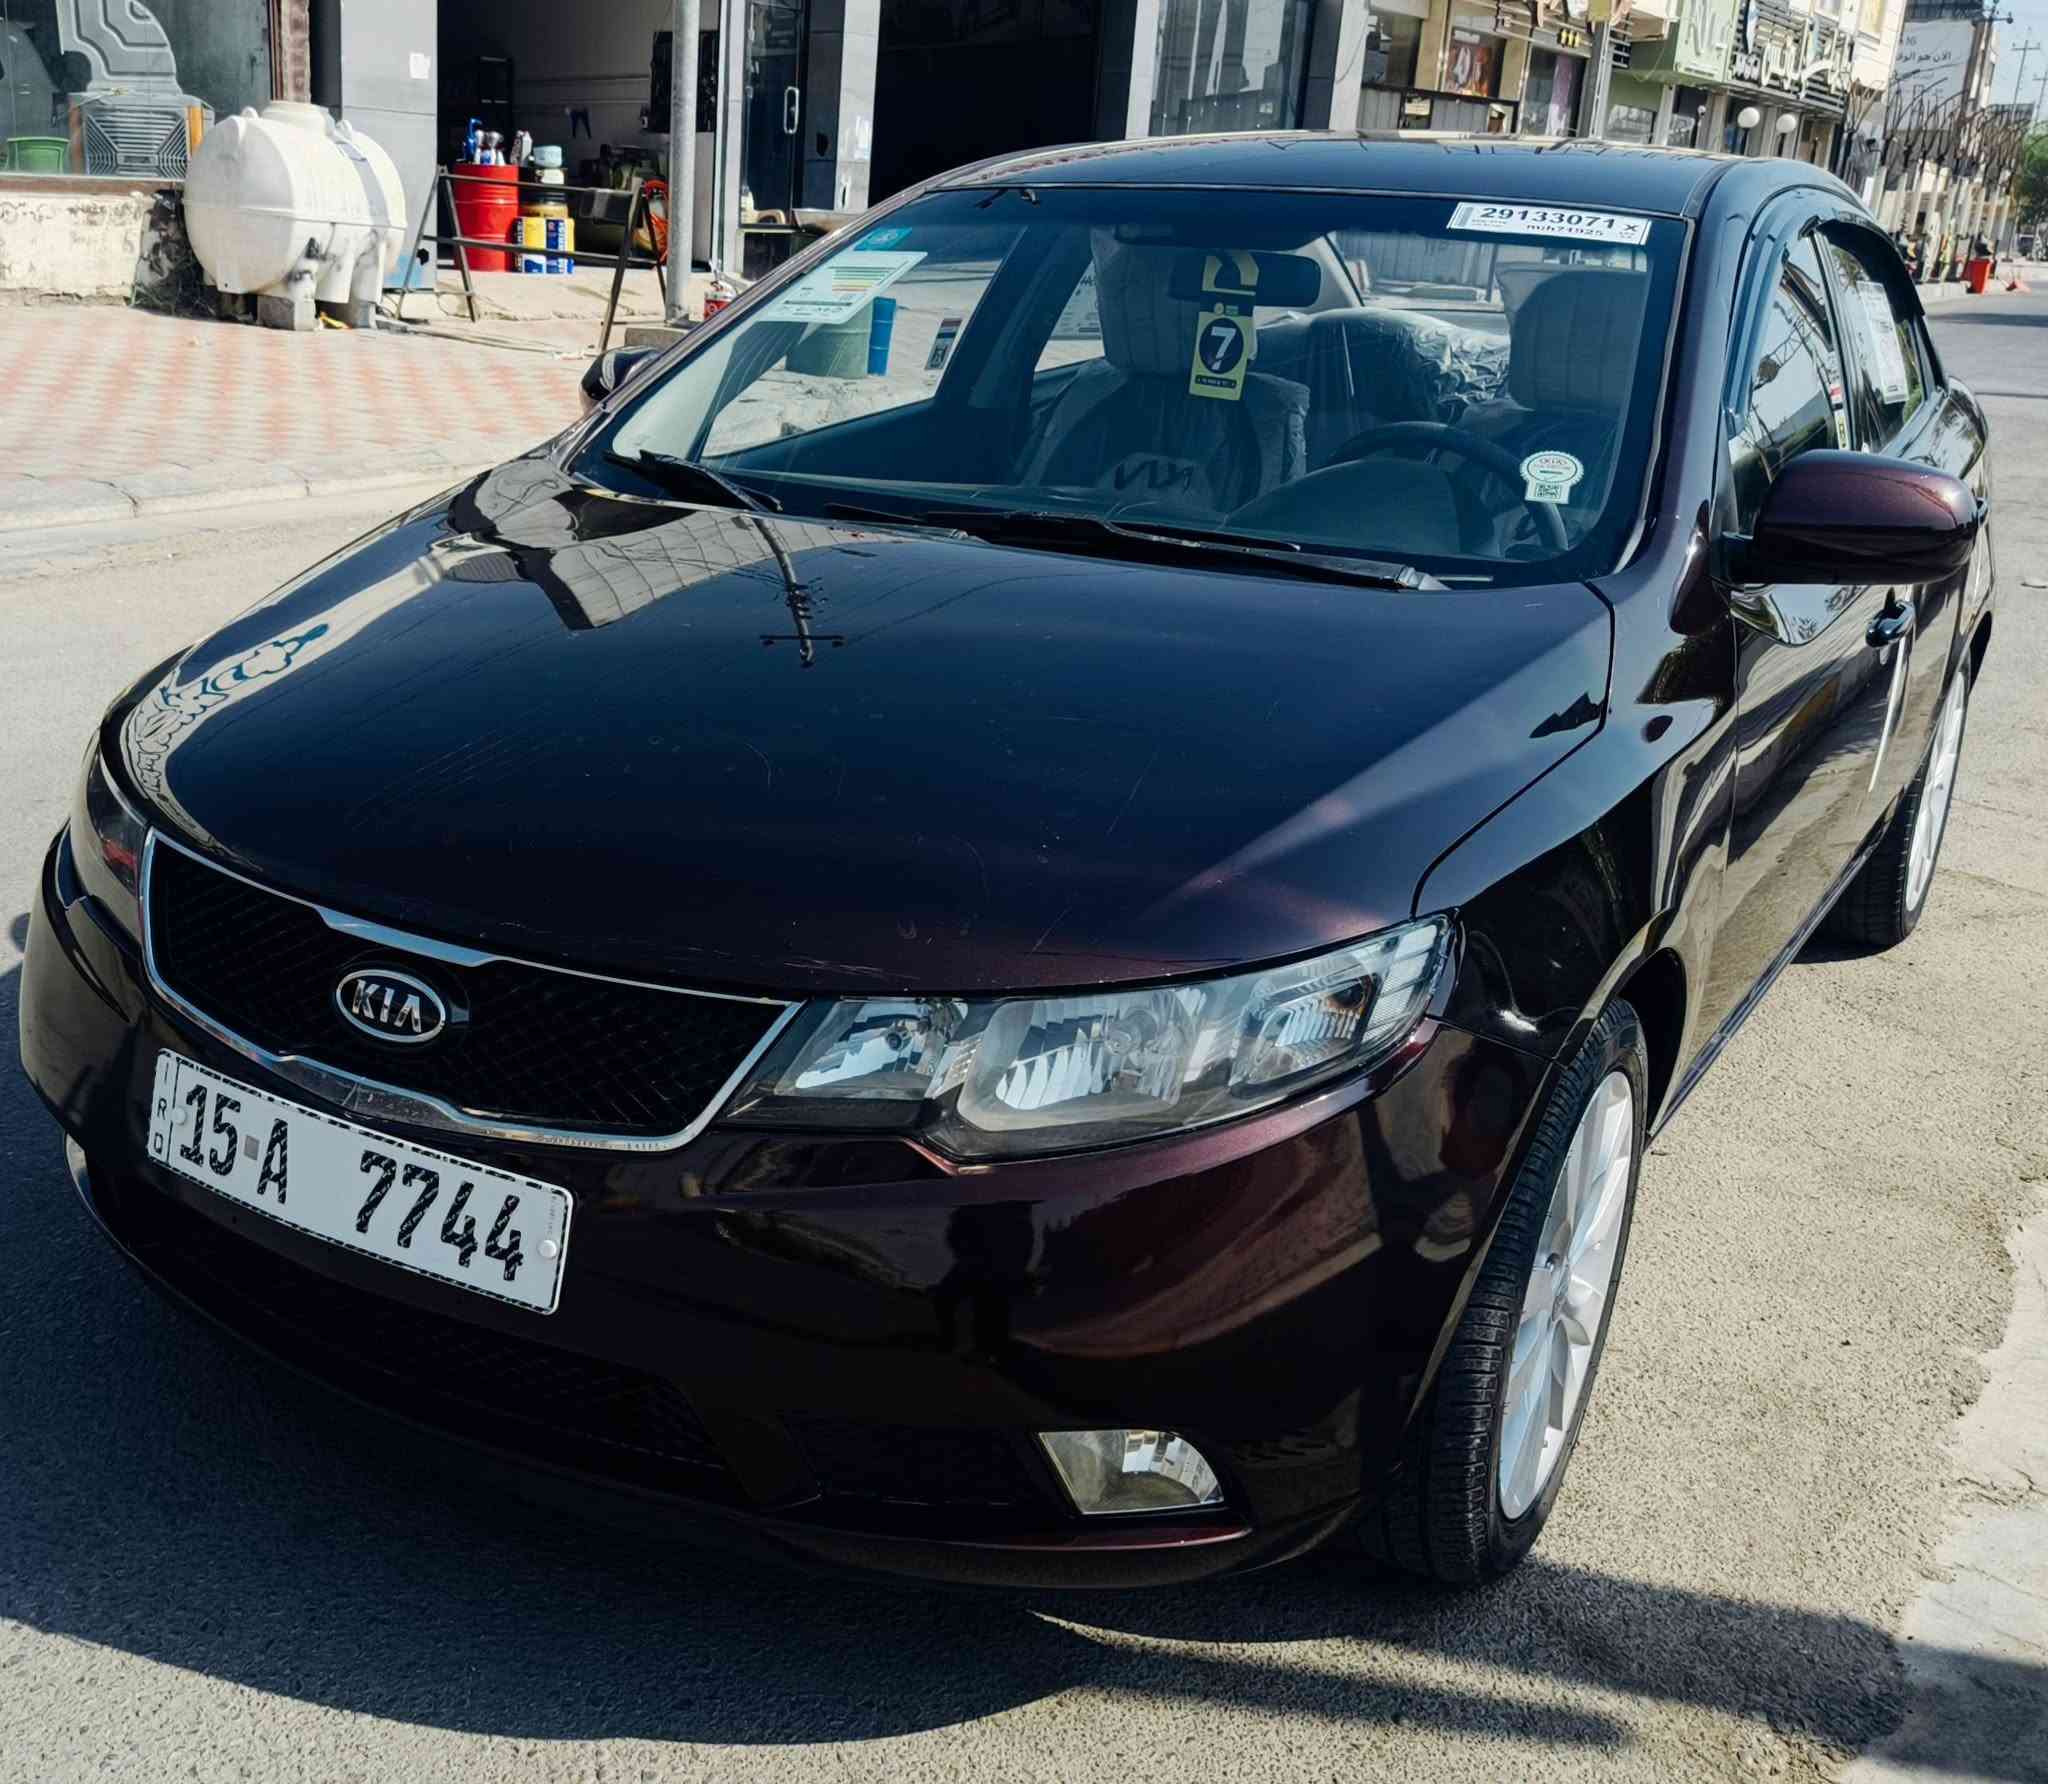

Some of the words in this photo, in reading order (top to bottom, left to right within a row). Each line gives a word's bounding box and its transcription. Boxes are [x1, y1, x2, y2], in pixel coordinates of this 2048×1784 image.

[1480, 207, 1616, 229] 29133071
[1211, 326, 1237, 371] 7
[352, 979, 422, 1033] KIA
[180, 1085, 241, 1177] 15
[257, 1118, 289, 1205] A
[355, 1150, 525, 1282] 7744
